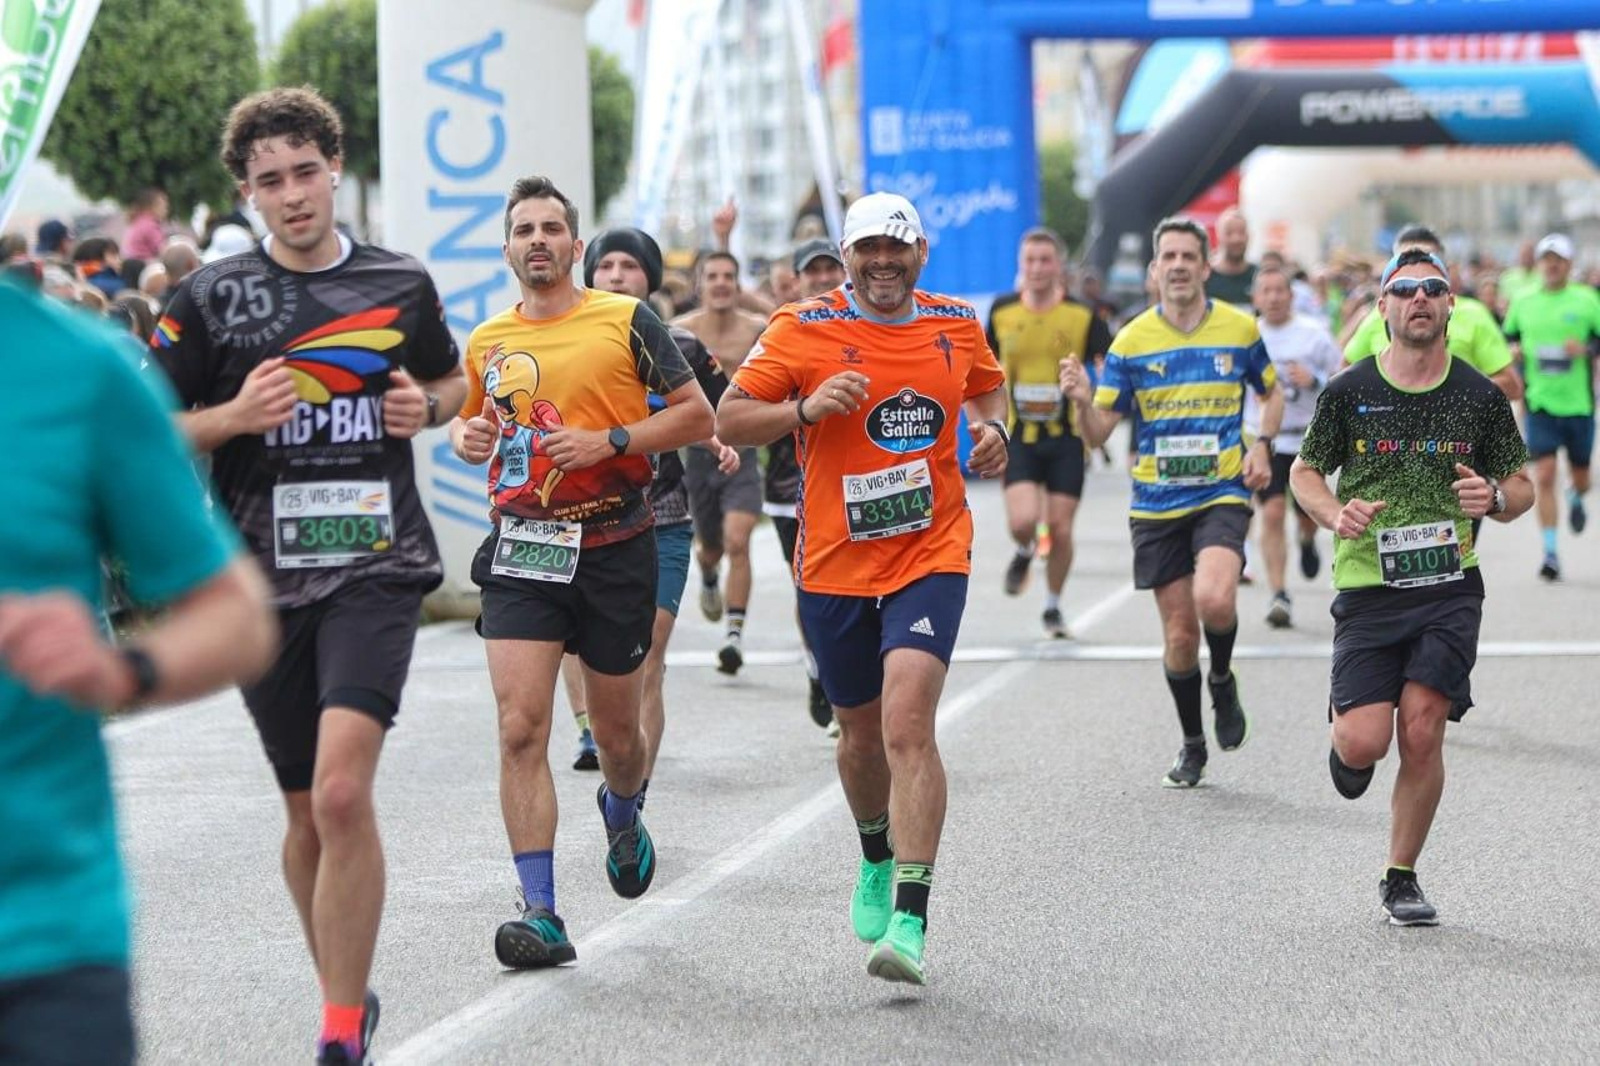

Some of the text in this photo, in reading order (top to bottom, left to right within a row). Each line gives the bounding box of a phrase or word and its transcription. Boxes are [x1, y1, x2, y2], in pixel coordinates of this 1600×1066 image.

[216, 275, 273, 327] 25
[880, 406, 934, 422] Estrella
[881, 421, 930, 438] Galicia
[1409, 439, 1473, 454] JUGUETES
[851, 469, 907, 496] 25 VIG BAY
[309, 488, 330, 504] VIG
[338, 488, 361, 503] BAY
[863, 490, 925, 524] 3314
[300, 516, 377, 547] 3603
[524, 520, 538, 534] VIG
[1386, 525, 1438, 547] 25 VIG BAY
[511, 542, 567, 568] 2820
[1397, 546, 1449, 573] 3101
